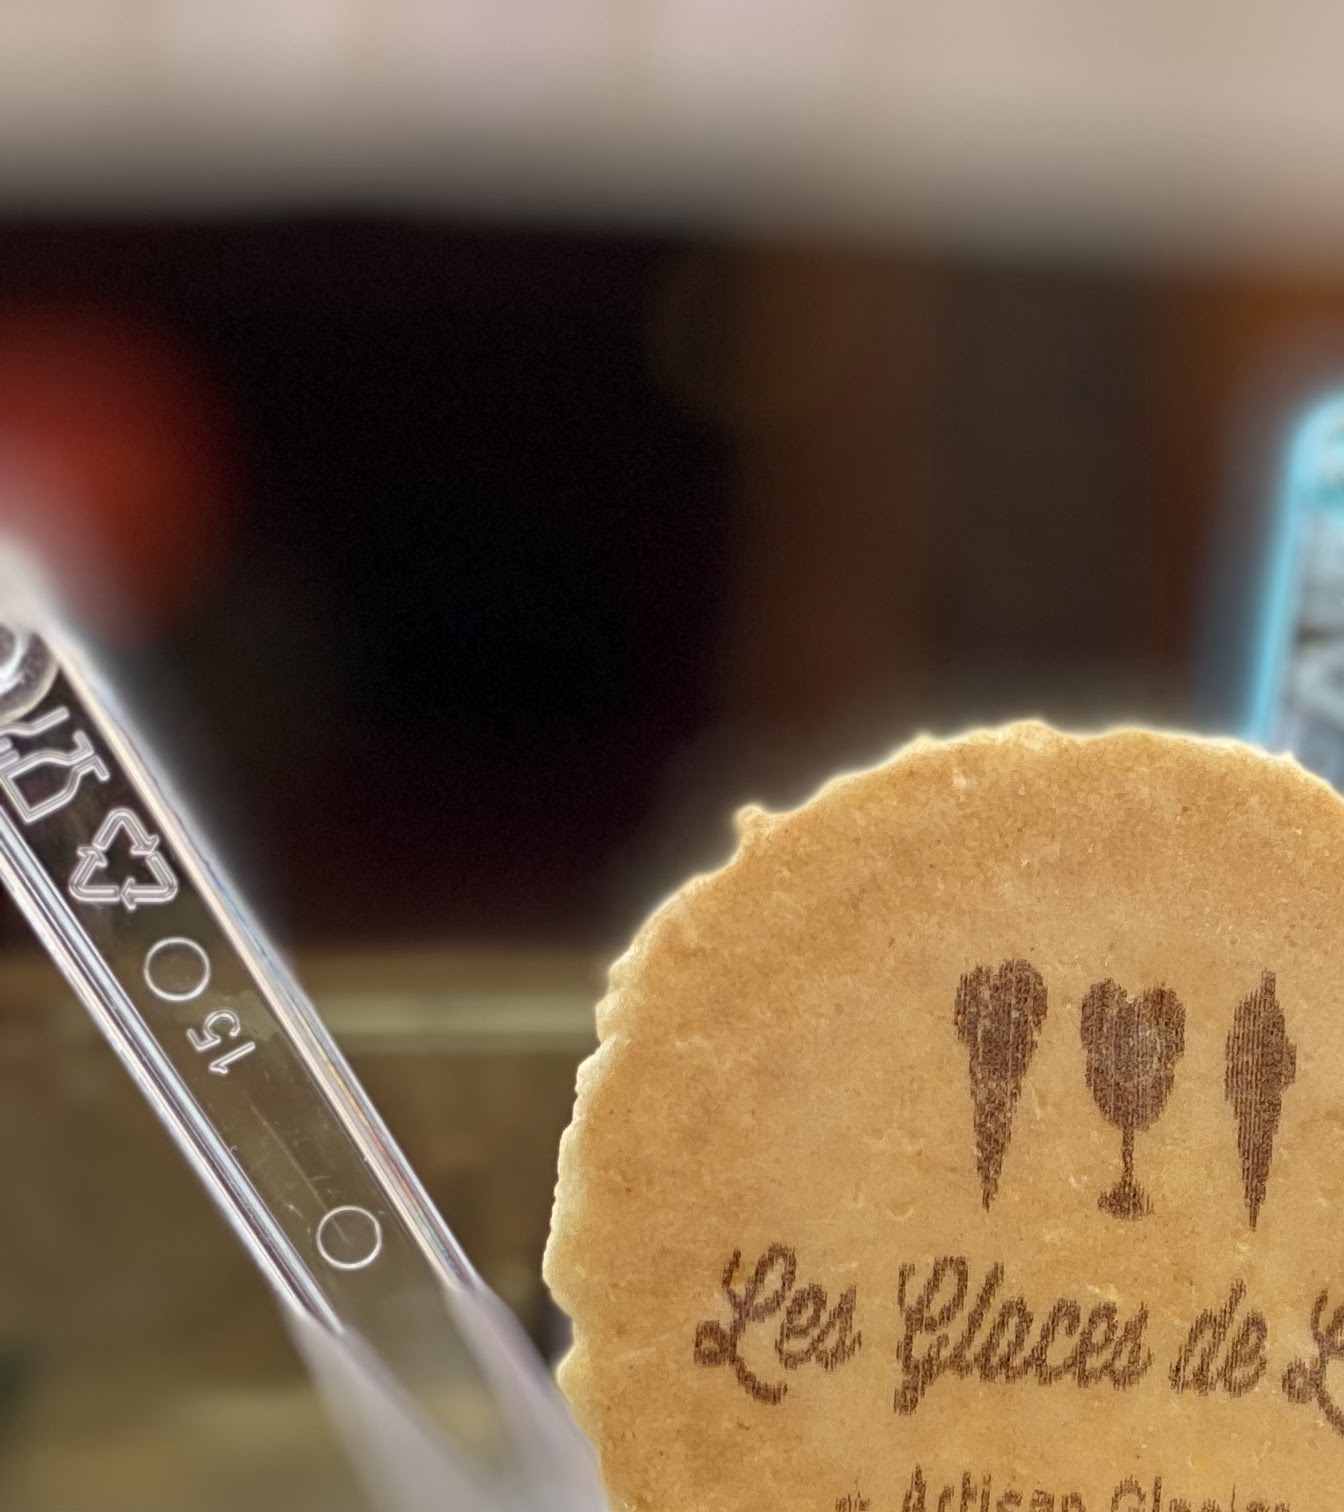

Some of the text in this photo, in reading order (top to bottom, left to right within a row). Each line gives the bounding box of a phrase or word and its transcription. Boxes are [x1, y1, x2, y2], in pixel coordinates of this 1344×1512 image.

[186, 1009, 255, 1074] 15
[694, 1242, 861, 1404] Les
[893, 1254, 1153, 1414] Glaces
[1169, 1279, 1268, 1397] de
